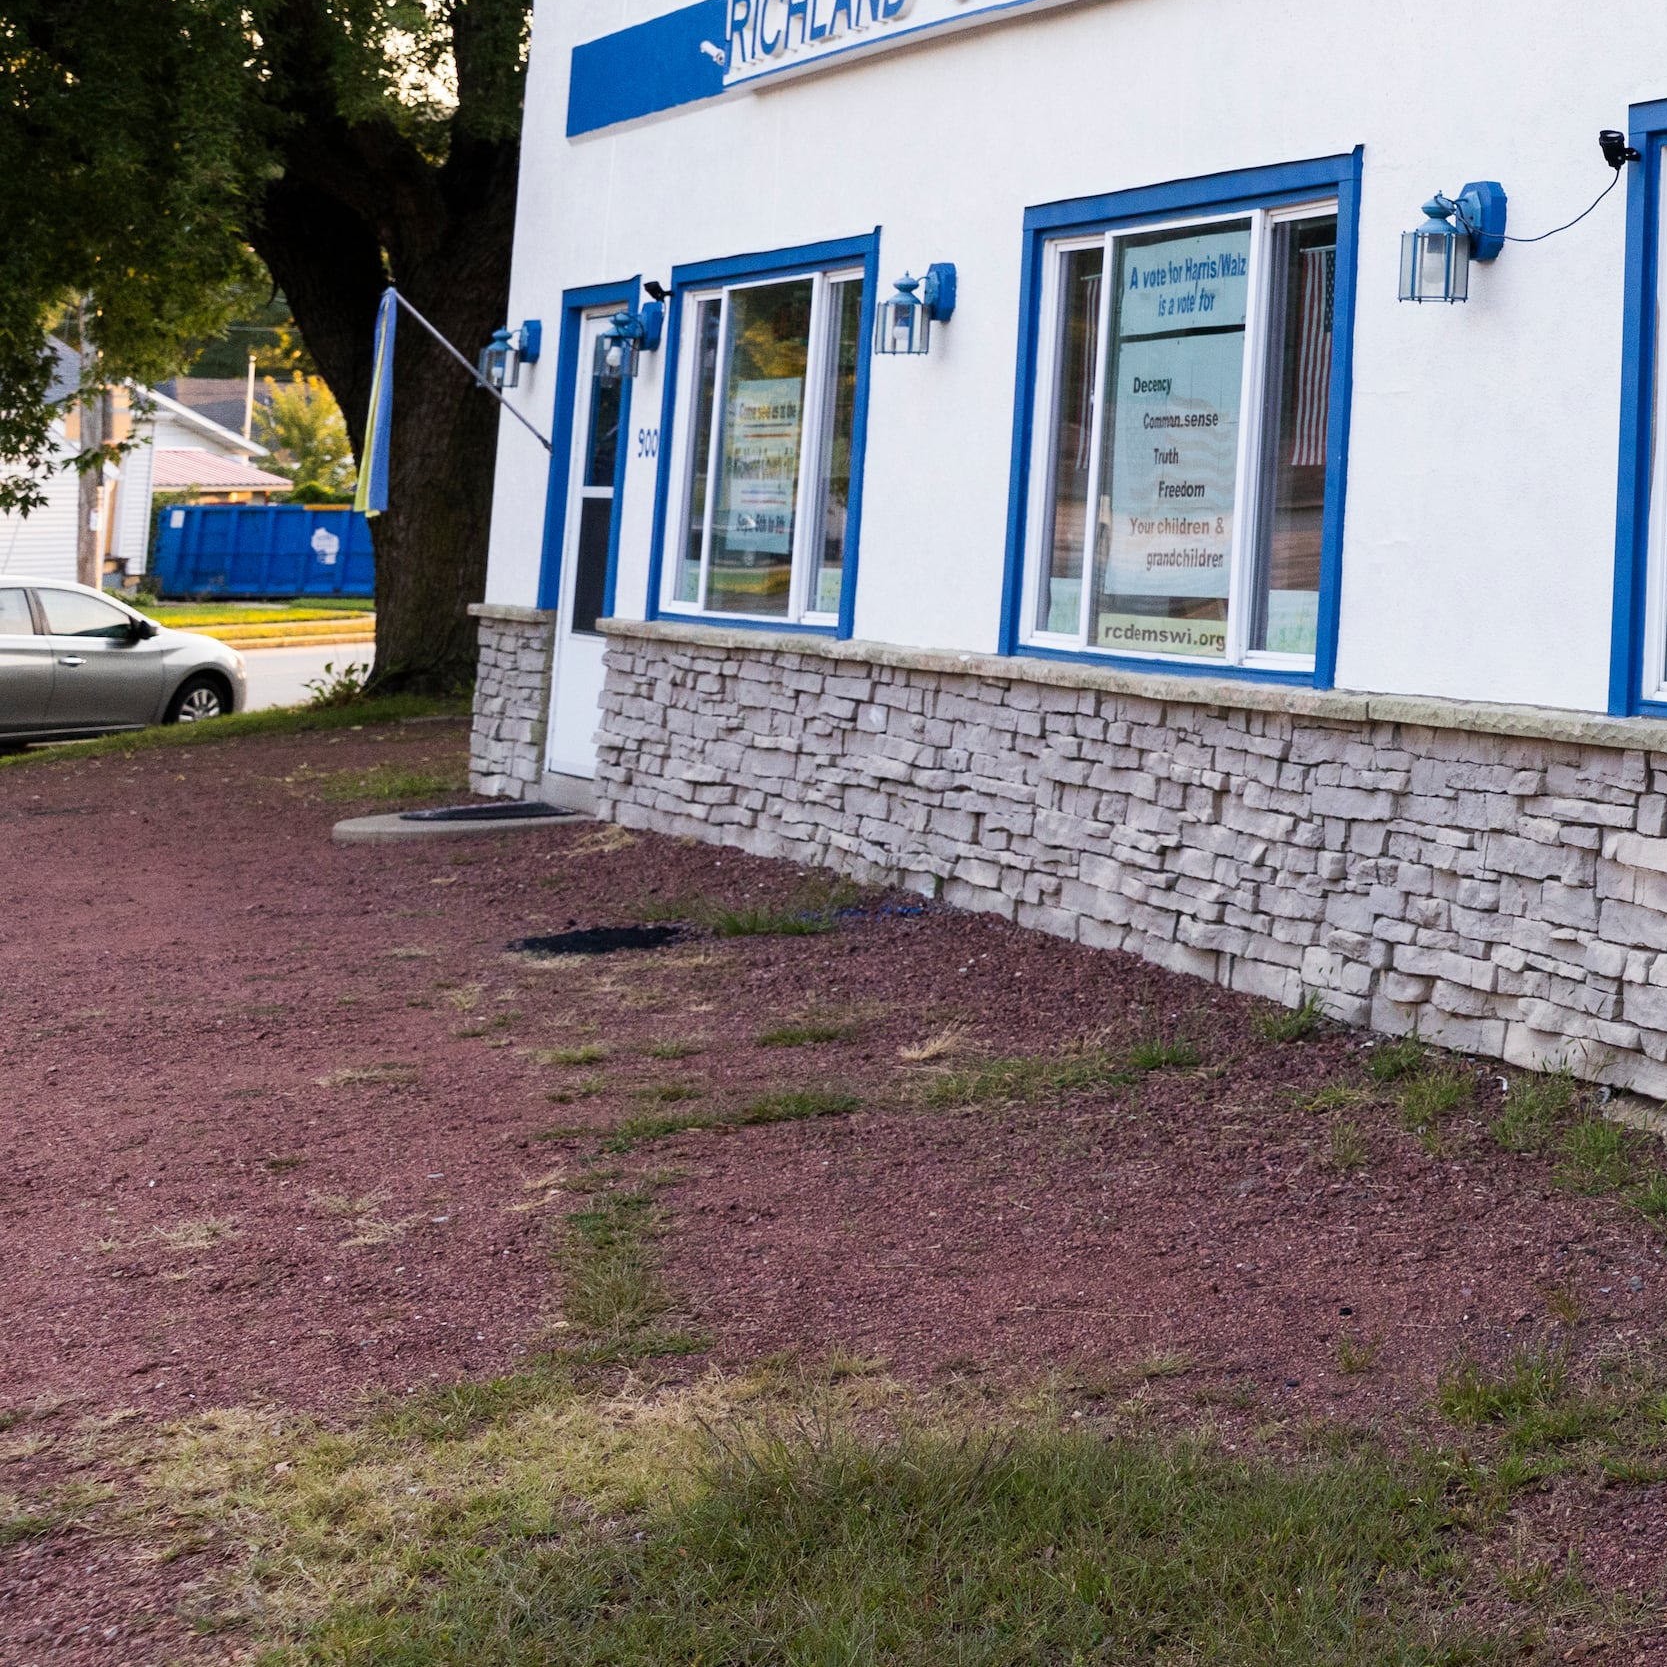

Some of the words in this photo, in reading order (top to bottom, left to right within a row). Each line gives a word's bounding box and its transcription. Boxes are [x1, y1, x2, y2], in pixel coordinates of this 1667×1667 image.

[1130, 267, 1138, 290] A
[1143, 268, 1166, 288] vote
[1169, 260, 1183, 284] for
[1185, 252, 1247, 282] Harris/Walz
[1158, 295, 1166, 317] is
[1168, 299, 1174, 315] a
[1177, 292, 1195, 314] vote
[1198, 287, 1216, 312] for
[1133, 377, 1172, 395] Decency
[1184, 412, 1219, 428] sense
[637, 427, 659, 459] 900
[1154, 447, 1179, 465] Truth
[1158, 480, 1205, 499] Freedom
[1130, 517, 1155, 537] Your
[1157, 517, 1210, 535] children
[1215, 516, 1224, 535] &
[1104, 624, 1225, 652] rcdemswi.org
